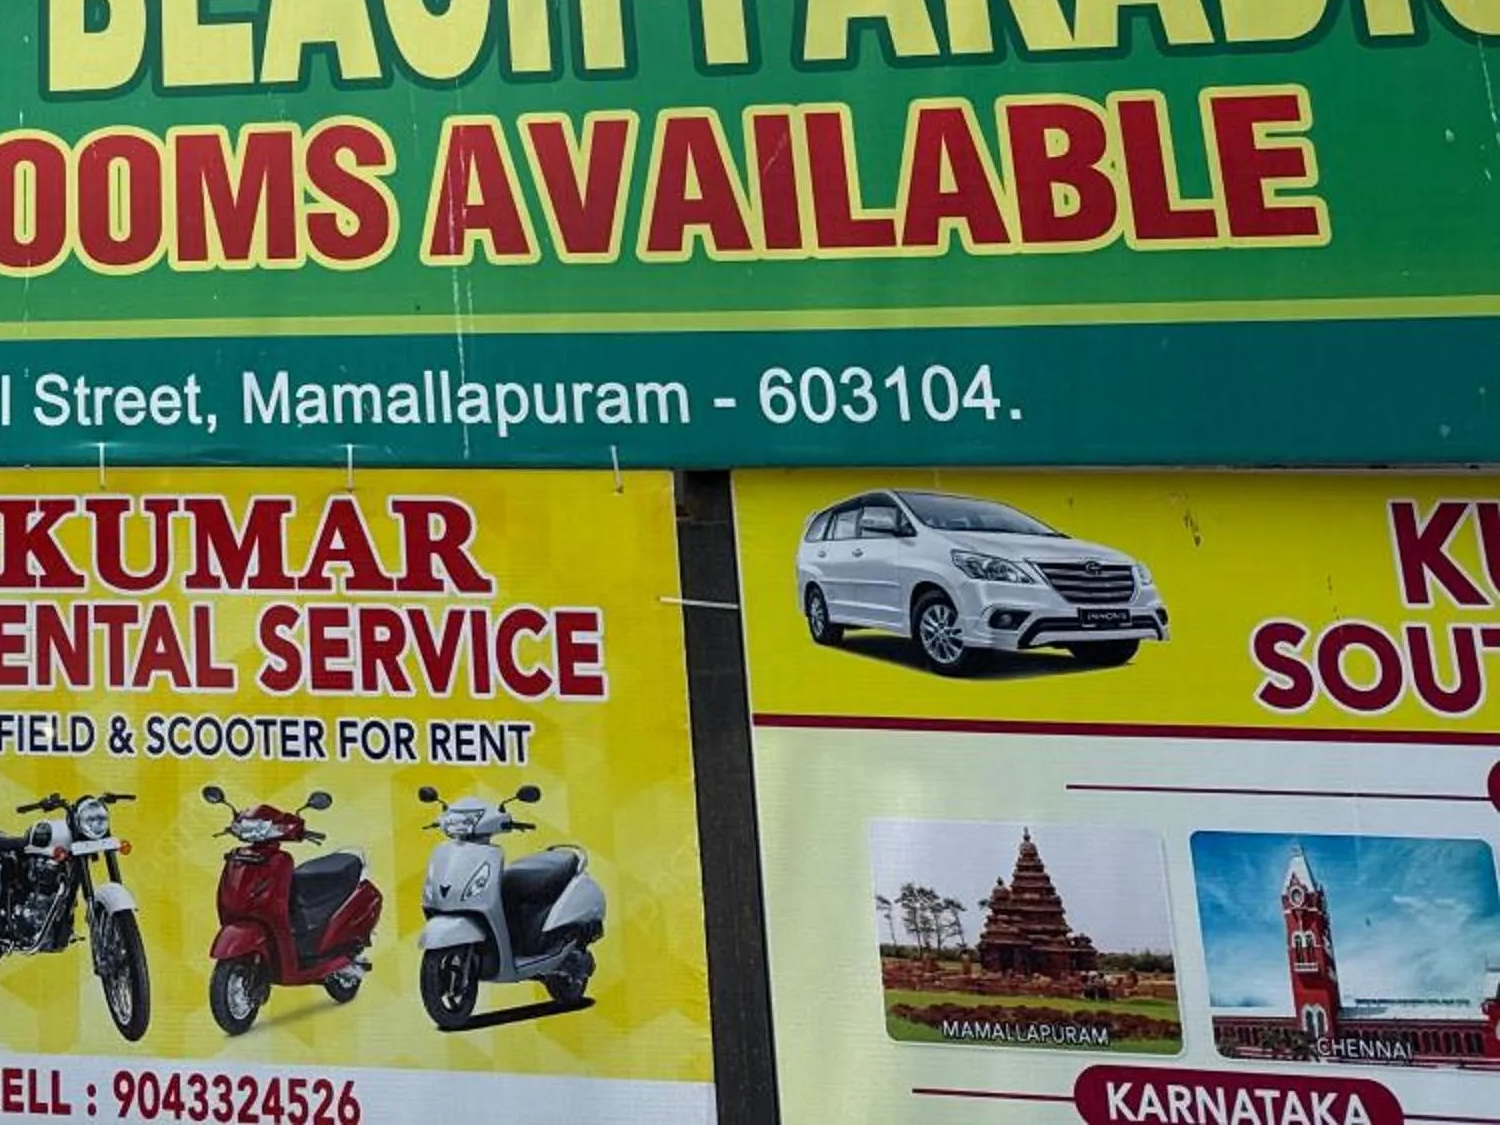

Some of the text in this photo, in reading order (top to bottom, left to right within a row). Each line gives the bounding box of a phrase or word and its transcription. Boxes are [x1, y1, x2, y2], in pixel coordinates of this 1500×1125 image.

[419, 83, 1331, 268] AVAILABLE
[30, 371, 218, 432] Street,
[242, 370, 690, 435] Mamallapuram
[758, 364, 1023, 423] 603104.
[258, 602, 609, 700] SERVICE
[1251, 619, 1500, 715] SOU
[108, 717, 135, 756] &
[145, 715, 326, 760] SCOOTER
[339, 720, 417, 762] FOR
[429, 722, 533, 765] RENT
[942, 1021, 1110, 1045] MAMALLAPURAM
[1317, 1038, 1413, 1061] CHENNAI
[113, 1068, 362, 1125] 9043324526
[1106, 1081, 1373, 1125] KARNATAKA
